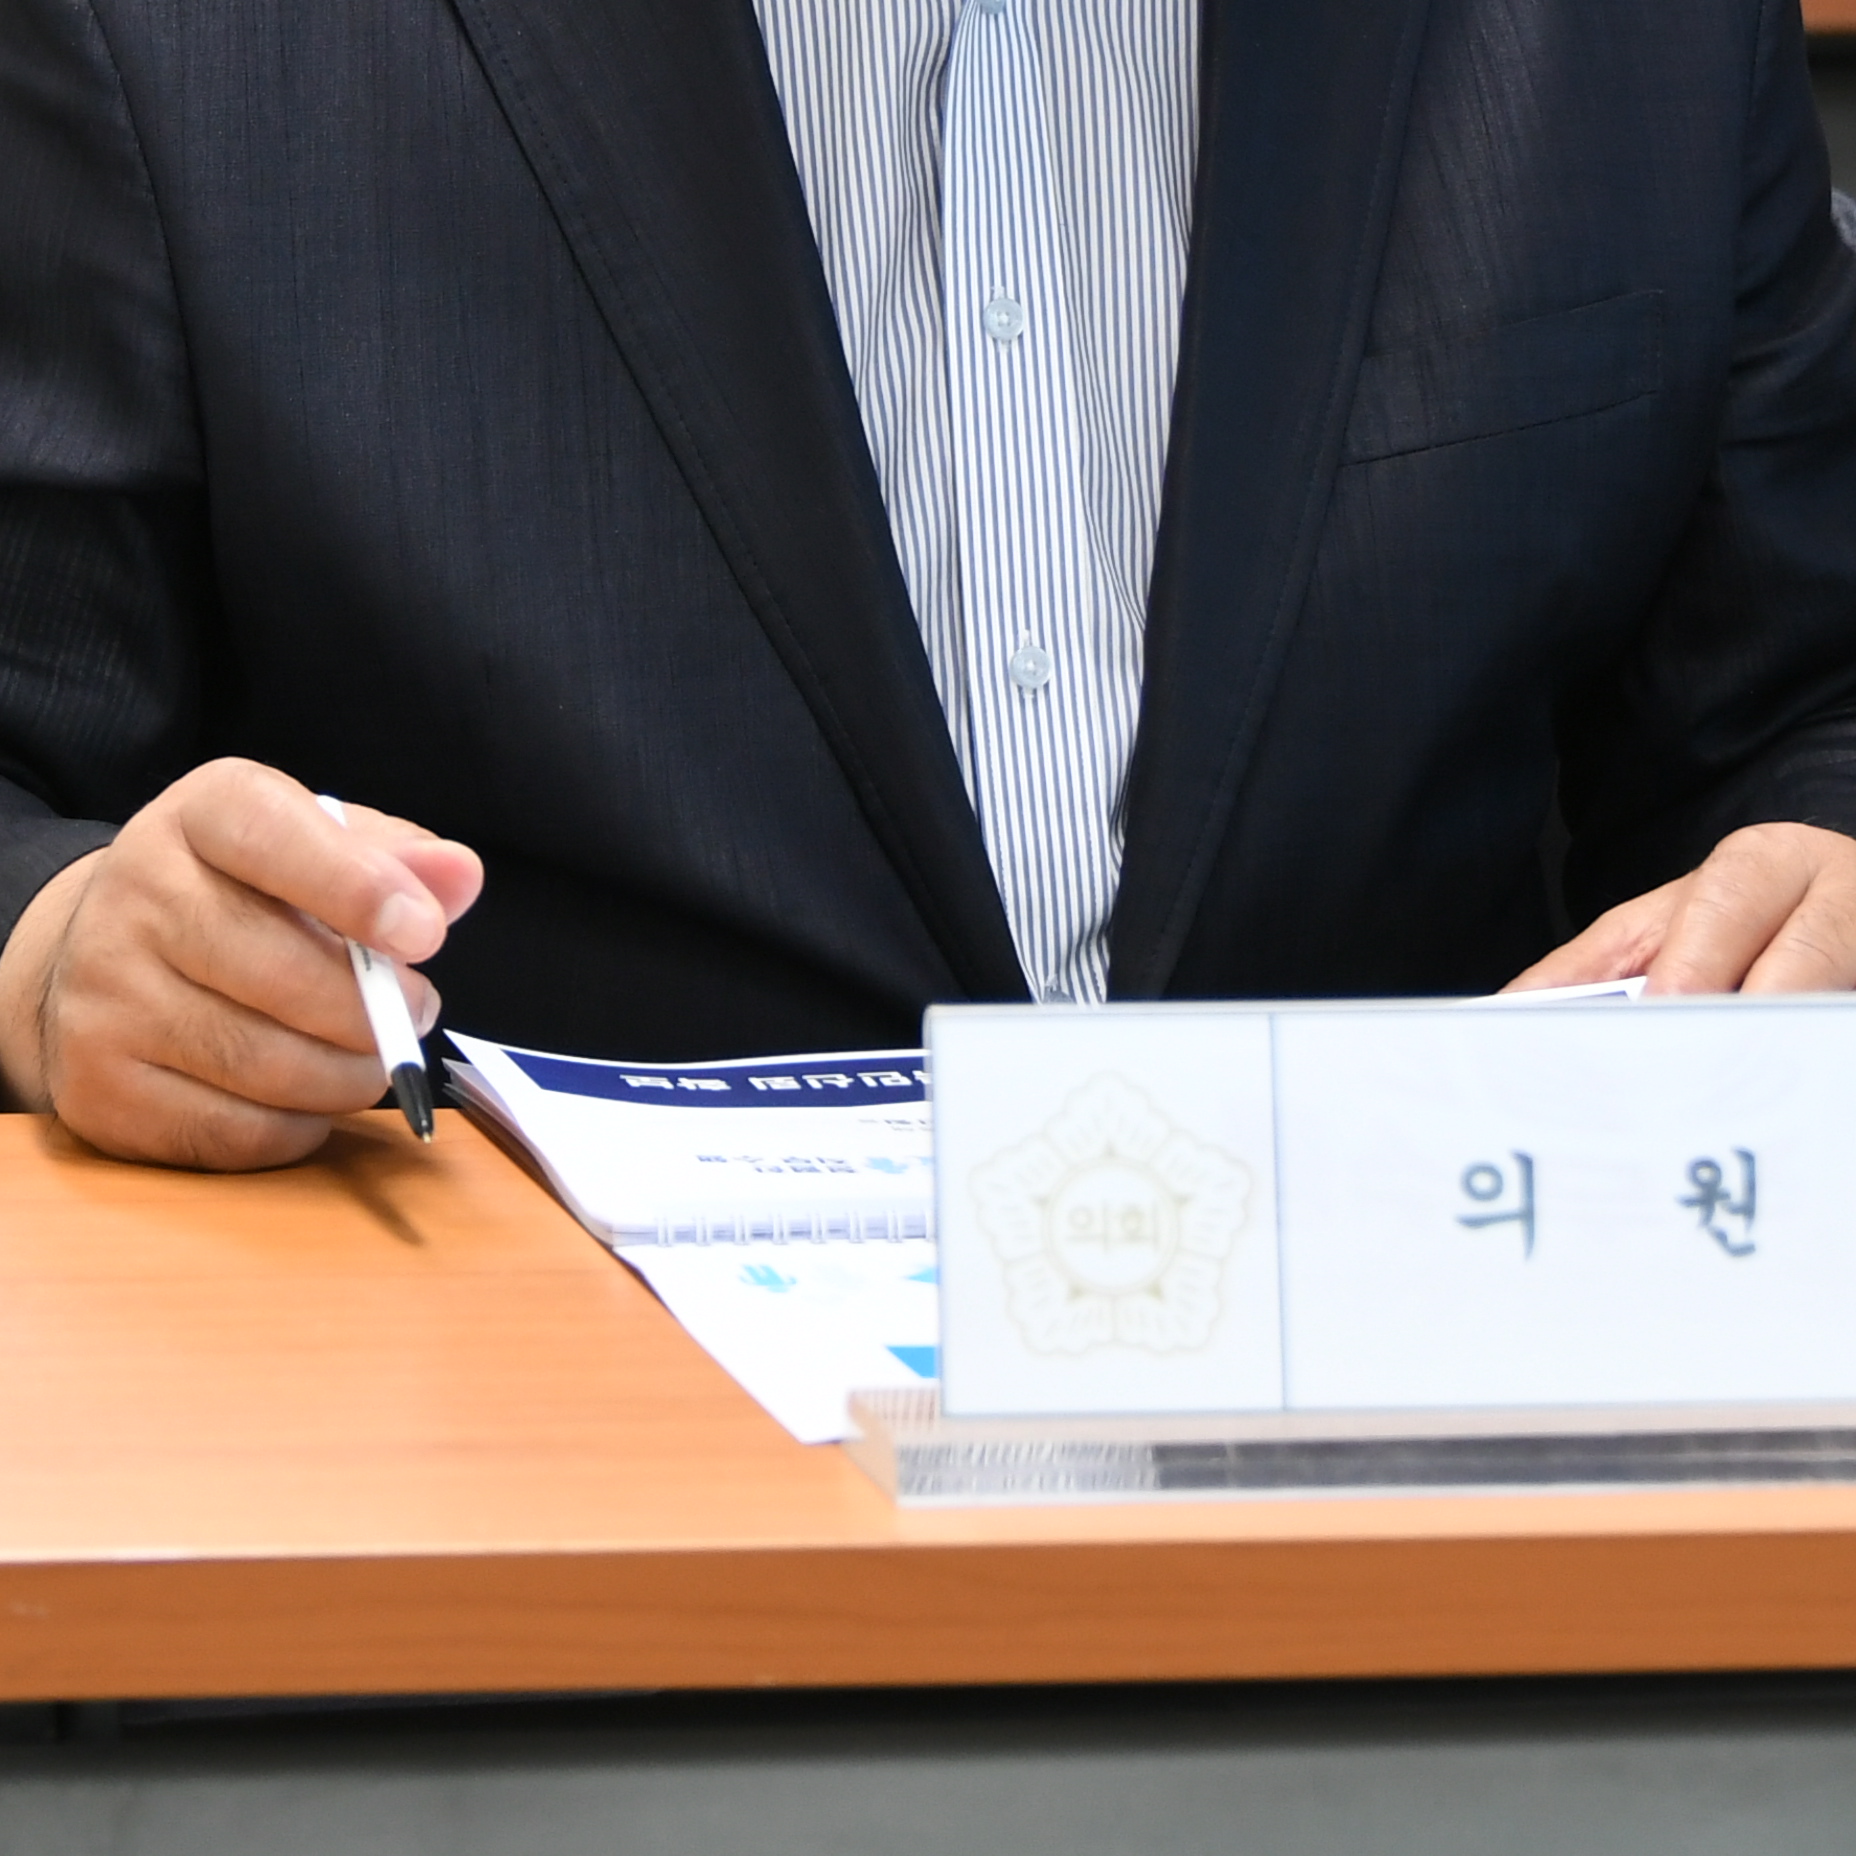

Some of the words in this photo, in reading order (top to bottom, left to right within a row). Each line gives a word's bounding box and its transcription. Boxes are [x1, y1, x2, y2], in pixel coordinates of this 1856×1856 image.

[1065, 1199, 1161, 1254] 의회
[1453, 1149, 1536, 1261] 의
[1675, 1146, 1757, 1258] 원
